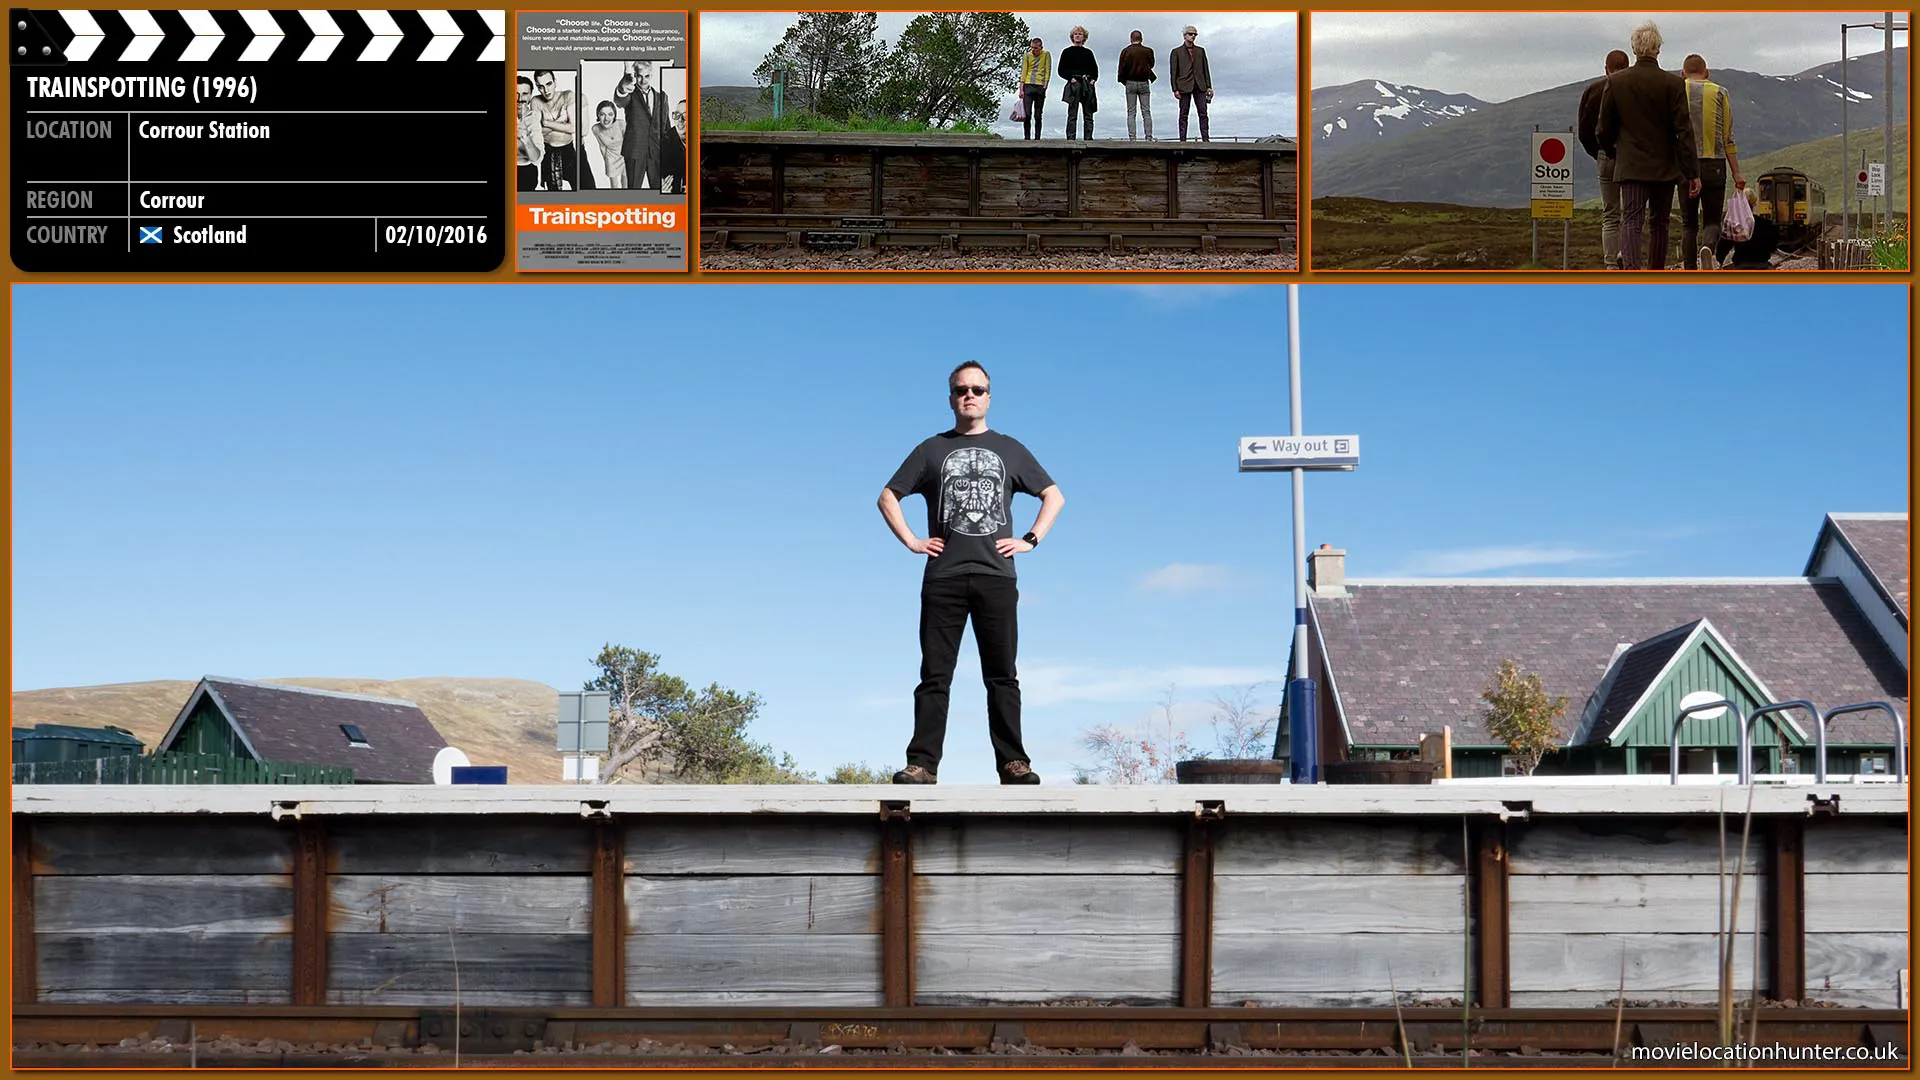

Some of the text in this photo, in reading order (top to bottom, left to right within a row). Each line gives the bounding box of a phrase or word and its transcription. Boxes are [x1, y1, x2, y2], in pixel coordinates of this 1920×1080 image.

[1535, 165, 1570, 180] Stop
[528, 207, 676, 228] Trainspotting
[1272, 440, 1328, 455] Way out
